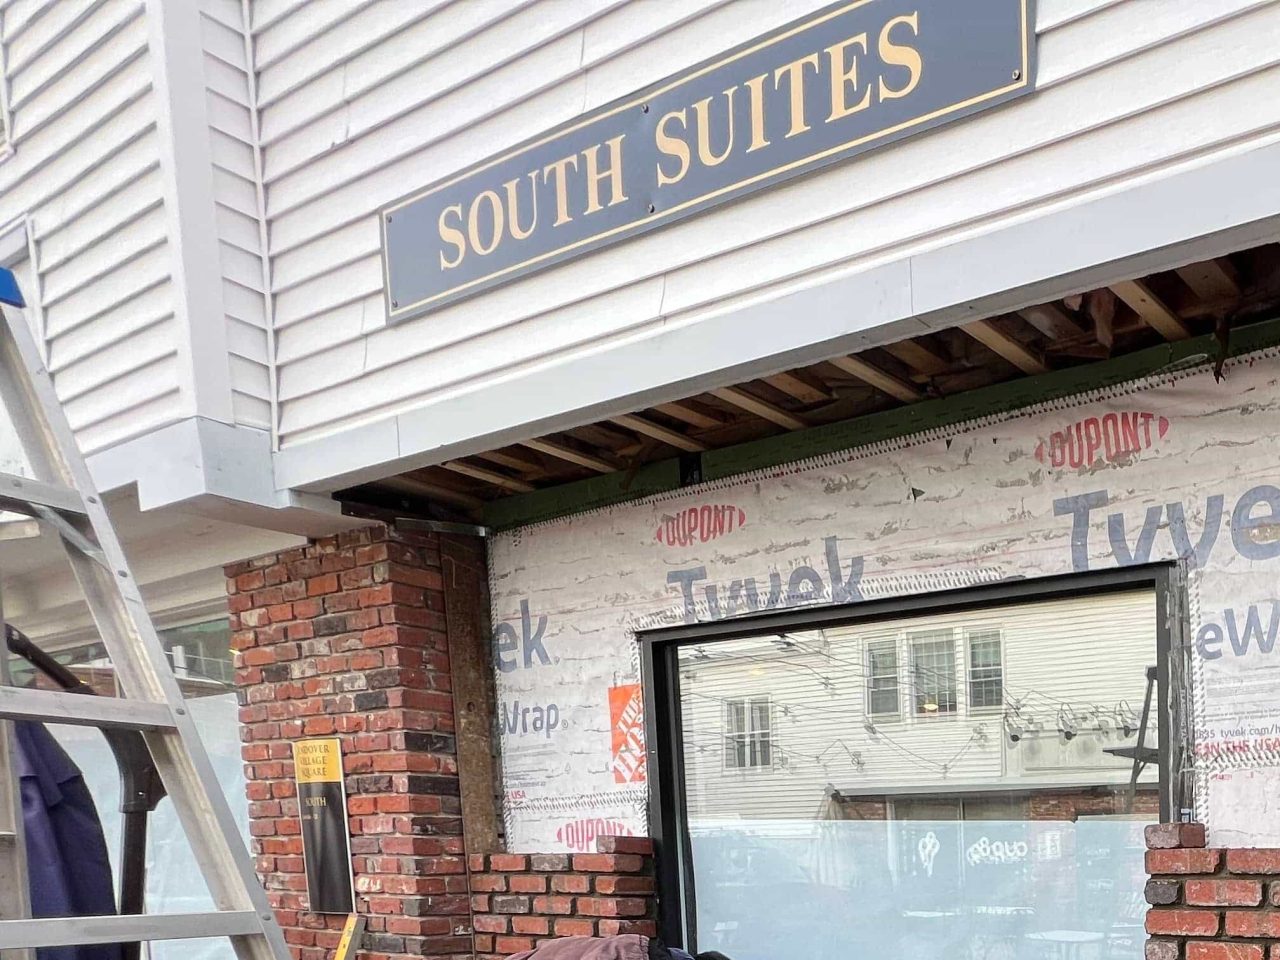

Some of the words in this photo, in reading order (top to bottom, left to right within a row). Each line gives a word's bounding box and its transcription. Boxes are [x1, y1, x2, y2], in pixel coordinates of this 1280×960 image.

[437, 133, 629, 271] SOUTH
[654, 10, 923, 187] SUITES
[1050, 411, 1155, 469] DUPONT
[665, 504, 736, 547] DUPONT
